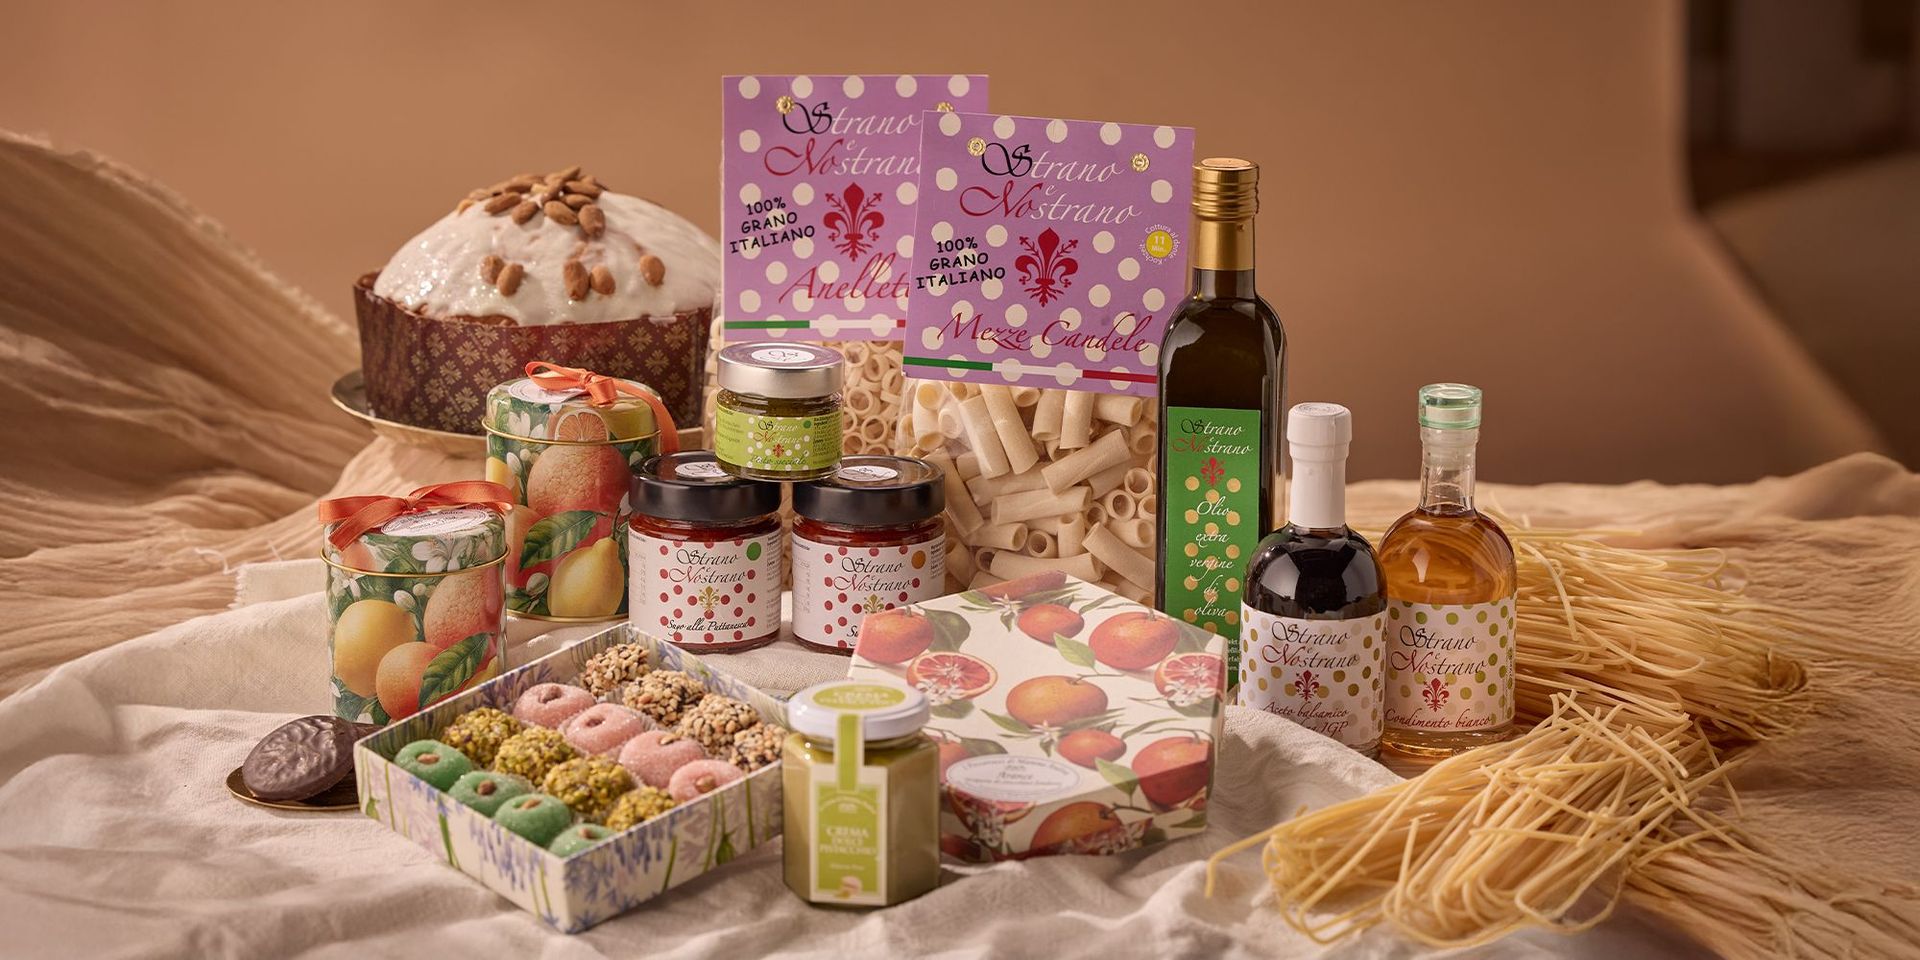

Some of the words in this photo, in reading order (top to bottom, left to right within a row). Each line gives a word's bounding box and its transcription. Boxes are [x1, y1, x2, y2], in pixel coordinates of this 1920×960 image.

[782, 101, 922, 136] Strano
[846, 139, 856, 151] e
[981, 142, 1125, 183] Strano
[1045, 184, 1057, 196] e
[745, 197, 787, 216] 100%
[959, 180, 1142, 224] Nostrano
[740, 211, 798, 234] GRANO
[1144, 224, 1171, 234] Cottura
[730, 225, 815, 253] ITALIANO
[936, 237, 978, 253] 100%
[1155, 236, 1165, 245] 11
[1170, 231, 1179, 239] al
[1168, 239, 1181, 259] dente
[929, 252, 989, 271] GRANO
[916, 267, 1006, 289] ITALIANO
[937, 312, 1035, 351] Mezze
[1041, 312, 1153, 352] Candele
[1180, 418, 1246, 436] Strano
[1172, 433, 1254, 455] Nostrano
[1196, 495, 1230, 517] Olio
[1195, 532, 1231, 548] extra
[676, 548, 742, 565] Strano
[841, 557, 906, 574] Strano
[668, 565, 748, 584] Nostrano
[1189, 558, 1235, 582] vergine
[833, 573, 913, 592] Nostrano
[1203, 574, 1224, 596] di
[1193, 597, 1230, 618] oliva
[667, 619, 686, 637] Sugo
[686, 617, 706, 631] alla
[1271, 620, 1351, 646] Strano
[1399, 625, 1478, 651] Strano
[1261, 644, 1361, 669] Nostrano
[1390, 649, 1489, 676] Nostrano
[1262, 701, 1296, 716] Aceto
[1297, 701, 1349, 719] balsamico
[1384, 707, 1452, 728] Condimento
[1455, 708, 1492, 729] bianco
[1321, 721, 1349, 738] IGP
[825, 826, 870, 838] CREMA
